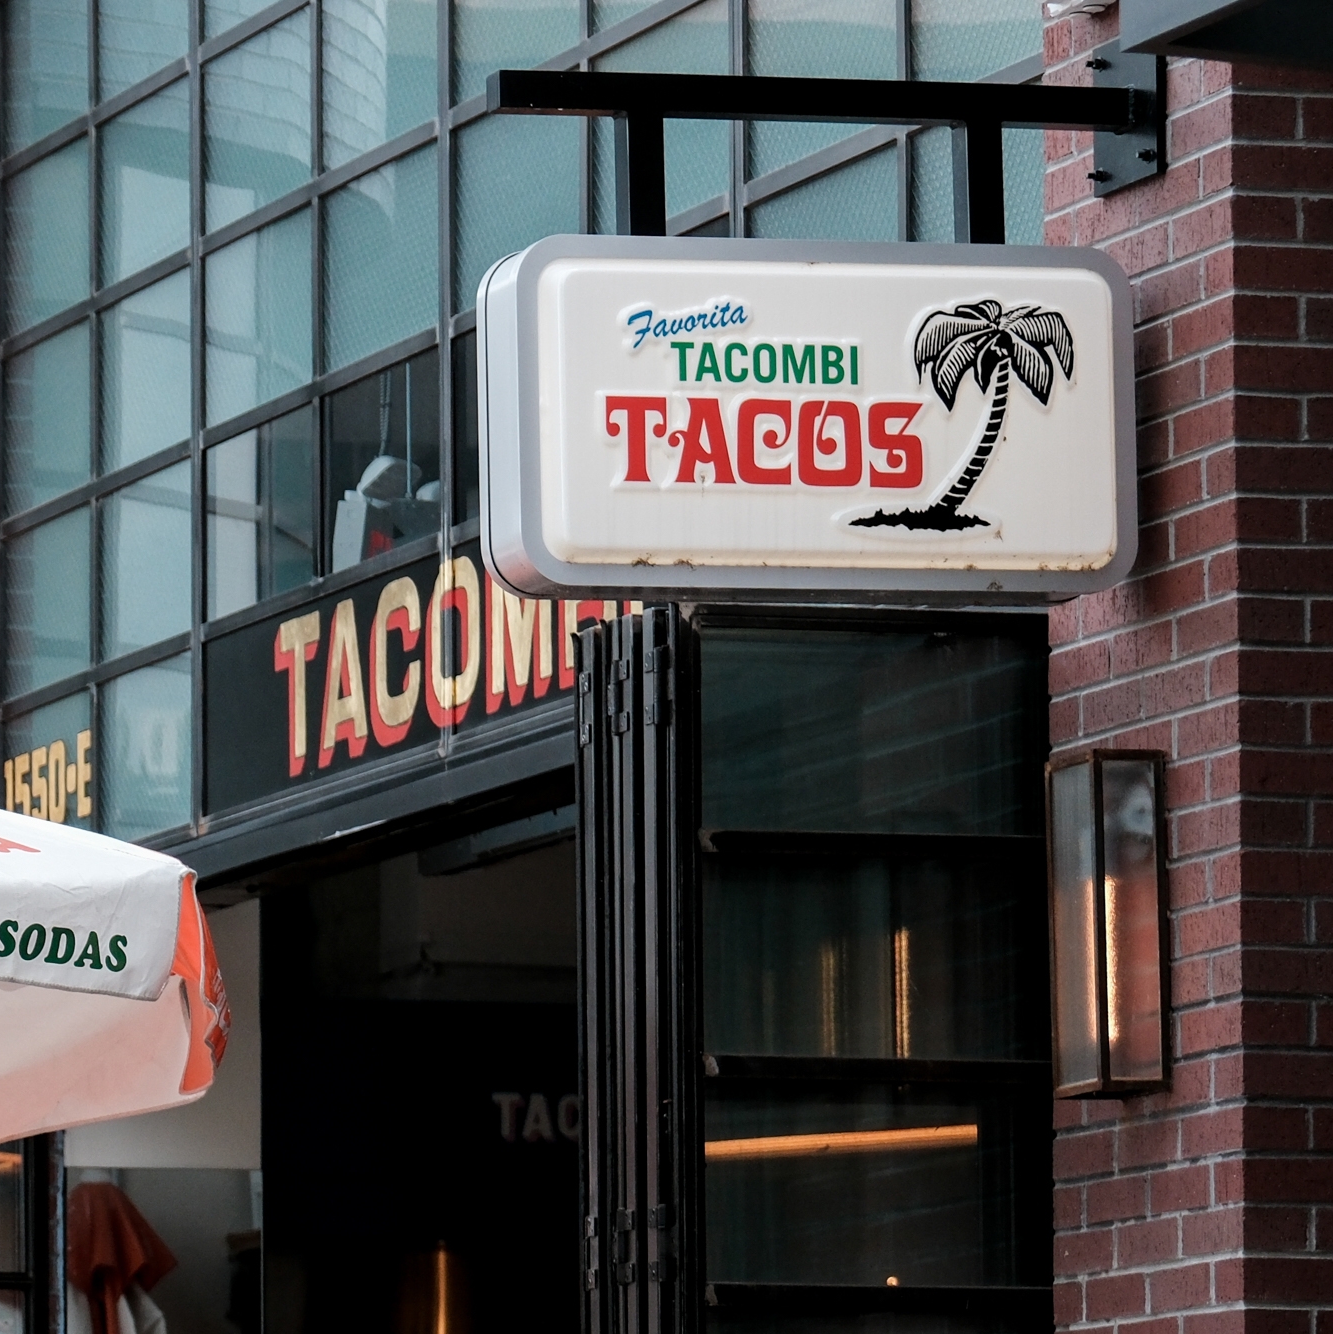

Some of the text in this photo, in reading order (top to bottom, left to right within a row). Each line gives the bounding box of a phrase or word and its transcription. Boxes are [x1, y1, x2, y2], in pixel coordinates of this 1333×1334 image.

[626, 300, 749, 350] Favorita
[670, 340, 859, 386] TACOMBI
[605, 395, 923, 489] TACOS
[274, 555, 643, 777] TACOM
